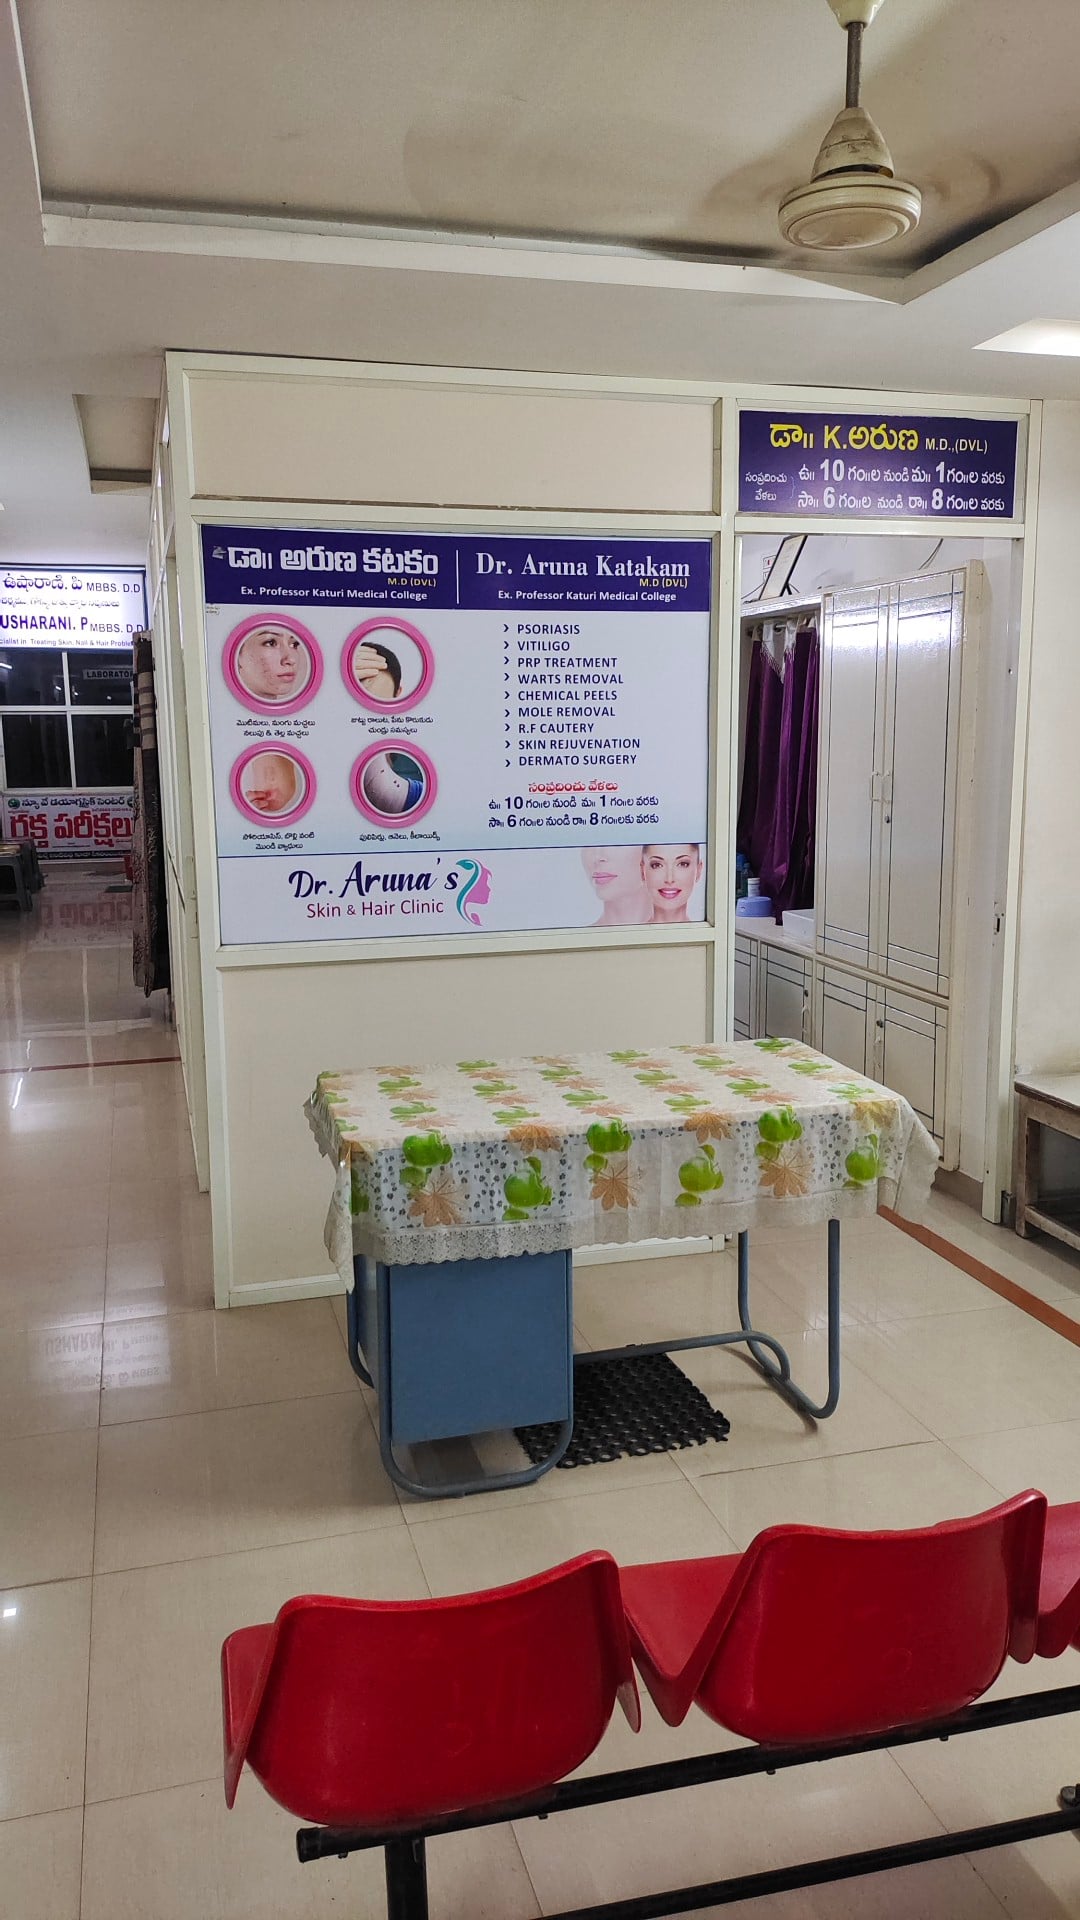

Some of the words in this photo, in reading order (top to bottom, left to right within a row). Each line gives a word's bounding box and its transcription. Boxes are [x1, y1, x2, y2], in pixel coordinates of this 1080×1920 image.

[820, 459, 845, 481] 10
[884, 467, 909, 482] నుండి
[981, 471, 1005, 484] వరకు
[745, 472, 787, 485] సంప్రదించు
[824, 487, 835, 508] 6
[878, 494, 903, 509] నుండి
[932, 488, 943, 510] 8
[981, 498, 1005, 511] వరకు
[280, 546, 357, 572] అరుణ
[363, 548, 438, 575] కటకం
[475, 552, 512, 575] Dr.
[521, 553, 588, 576] Aruna
[596, 555, 690, 577] Katakam
[388, 578, 407, 586] M.D
[410, 578, 437, 587] (DVL)
[639, 578, 659, 587] M.D
[662, 578, 688, 588] (DVL)
[241, 586, 256, 596] Ex.
[259, 587, 309, 597] Professor
[312, 588, 344, 598] Katuri
[347, 589, 387, 599] Medical
[390, 590, 427, 601] College
[498, 590, 513, 600] Ex.
[516, 591, 564, 600] Professor
[566, 591, 596, 600] Katuri
[599, 591, 638, 601] Medical
[641, 591, 676, 602] College
[81, 617, 88, 630] P
[517, 624, 580, 635] PSORIASIS
[30, 639, 56, 647] Treating
[518, 641, 570, 651] VITILIGO
[518, 658, 541, 668] PRP
[544, 657, 617, 668] TREATMENT
[518, 674, 561, 684] WARTS
[565, 674, 624, 684] REMOVAL
[518, 691, 580, 701] CHEMICAL
[584, 691, 617, 700] PEELS
[518, 707, 553, 717] MOLE
[556, 707, 615, 717] REMOVAL
[518, 723, 536, 734] R.F
[540, 723, 594, 733] CAUTERY
[518, 740, 546, 750] SKIN
[550, 738, 640, 749] REJUVENATION
[519, 755, 579, 766] DERMATO
[583, 755, 637, 765] SURGERY
[528, 782, 585, 795] సంప్రదించు
[505, 796, 523, 809] 10
[553, 796, 577, 808] నుండి
[600, 795, 606, 807] 1
[636, 796, 658, 806] వరకు
[507, 814, 516, 827] 6
[546, 814, 570, 826] నుండి
[590, 812, 598, 825] 8
[636, 814, 659, 823] వరకు
[288, 870, 333, 898] Dr.
[307, 903, 341, 918] Skin
[347, 904, 356, 915] &
[362, 901, 396, 916] Hair
[400, 899, 444, 914] Clinic
